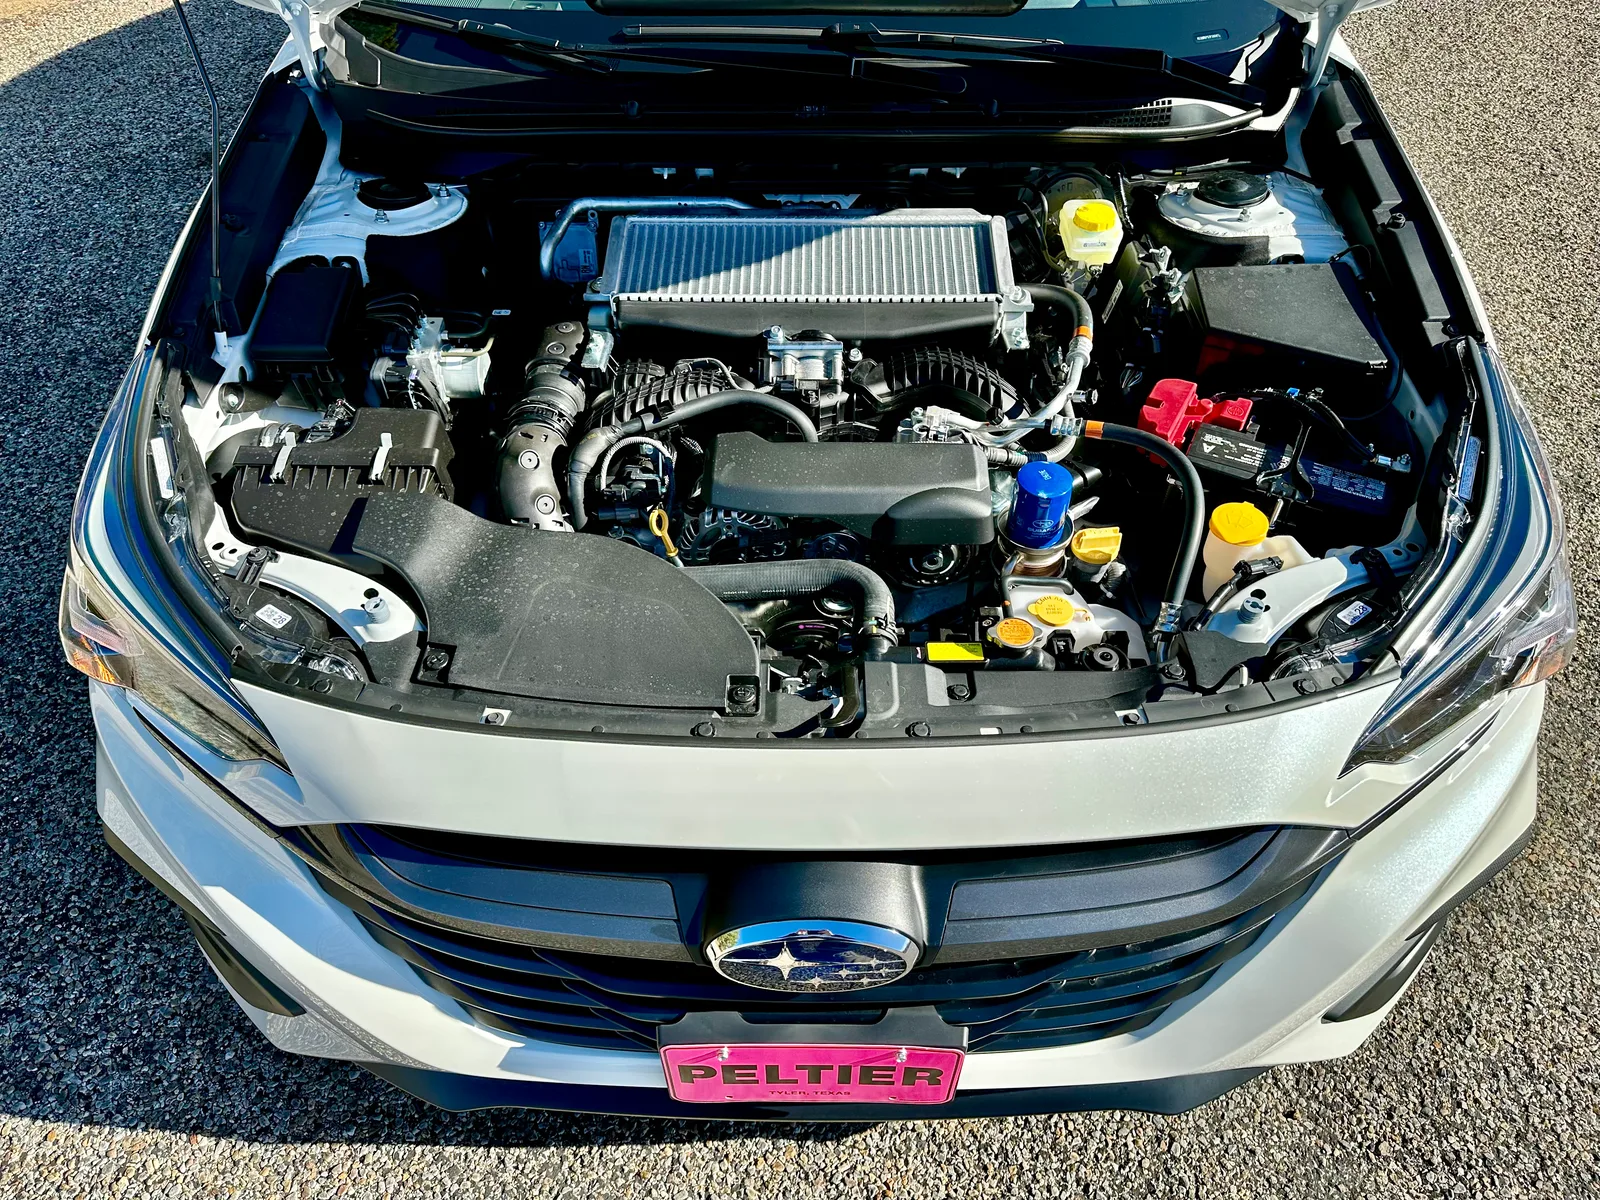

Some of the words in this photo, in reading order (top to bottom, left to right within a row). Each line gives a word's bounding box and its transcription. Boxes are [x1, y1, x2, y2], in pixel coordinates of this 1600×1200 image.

[1355, 605, 1368, 615] 28
[273, 615, 286, 624] 28
[678, 1064, 944, 1086] PELTIER
